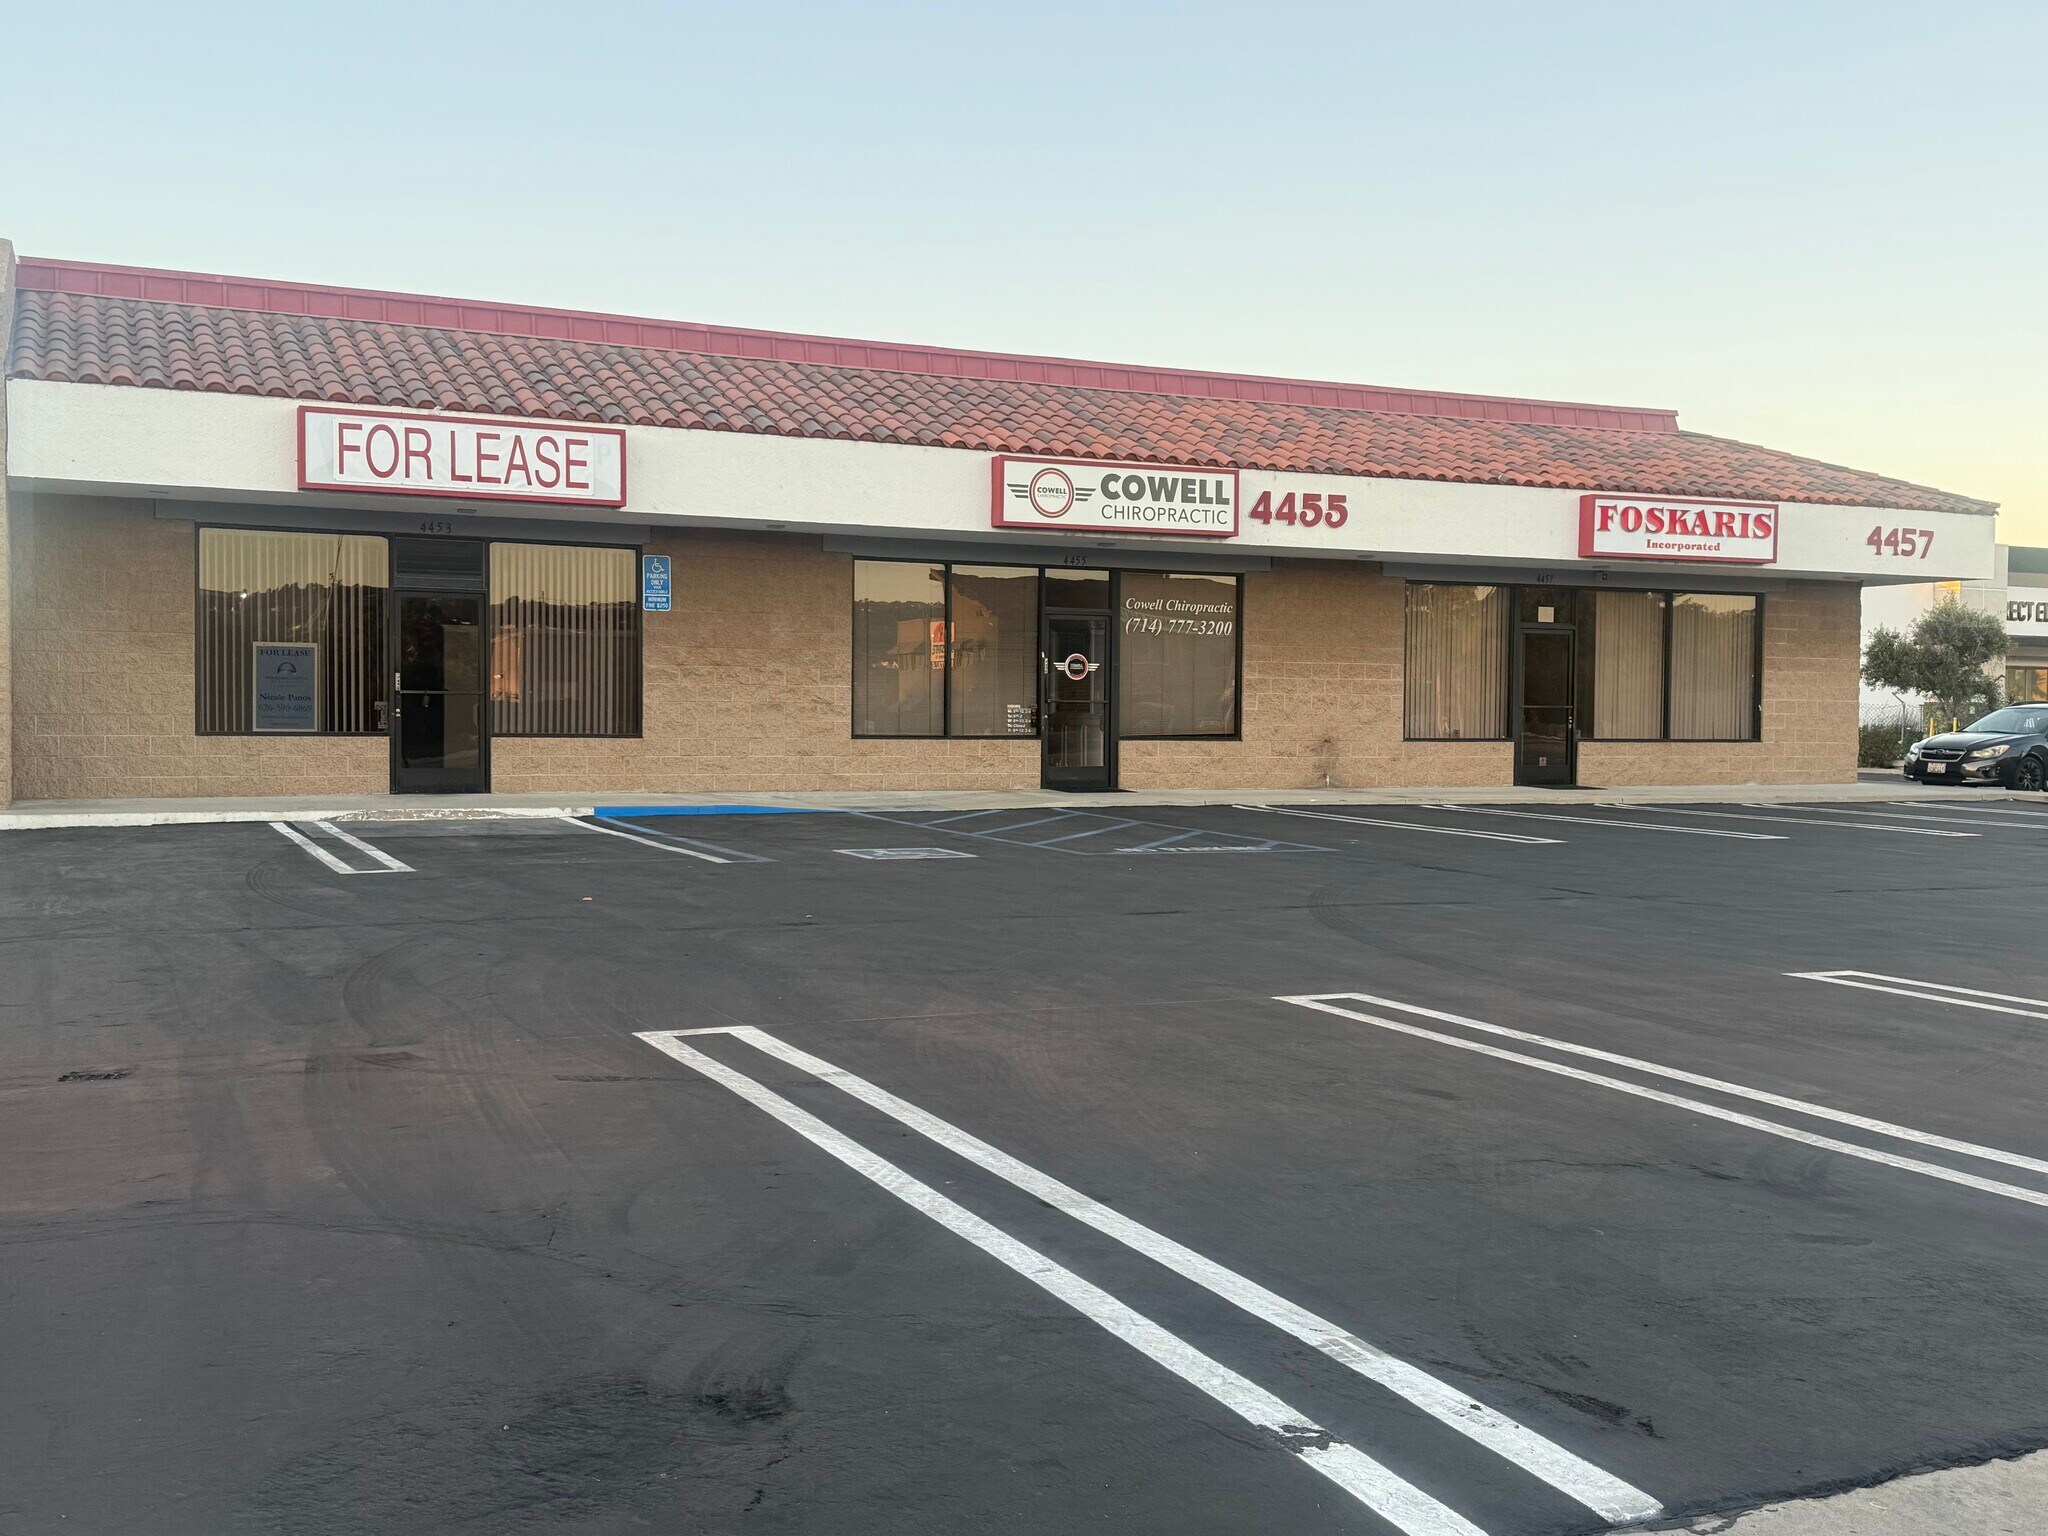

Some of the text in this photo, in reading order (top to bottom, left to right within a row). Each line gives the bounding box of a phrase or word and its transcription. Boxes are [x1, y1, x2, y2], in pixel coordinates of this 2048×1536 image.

[338, 422, 590, 490] FOR LEASE
[1037, 486, 1067, 495] COWELL
[1100, 473, 1230, 506] COWELL
[1101, 504, 1228, 525] CHIROPRACTIC
[1249, 490, 1349, 529] 4455
[419, 520, 452, 535] 4453
[1596, 504, 1773, 540] FOSKARIS
[1646, 539, 1721, 552] Incorporated
[1865, 525, 1935, 559] 4457
[1063, 554, 1088, 566] 4455
[1125, 597, 1233, 615] Cowell Chiropractic
[1125, 617, 1233, 637] (714) 777-3200
[281, 649, 312, 657] LEASE
[259, 693, 286, 701] Nicole
